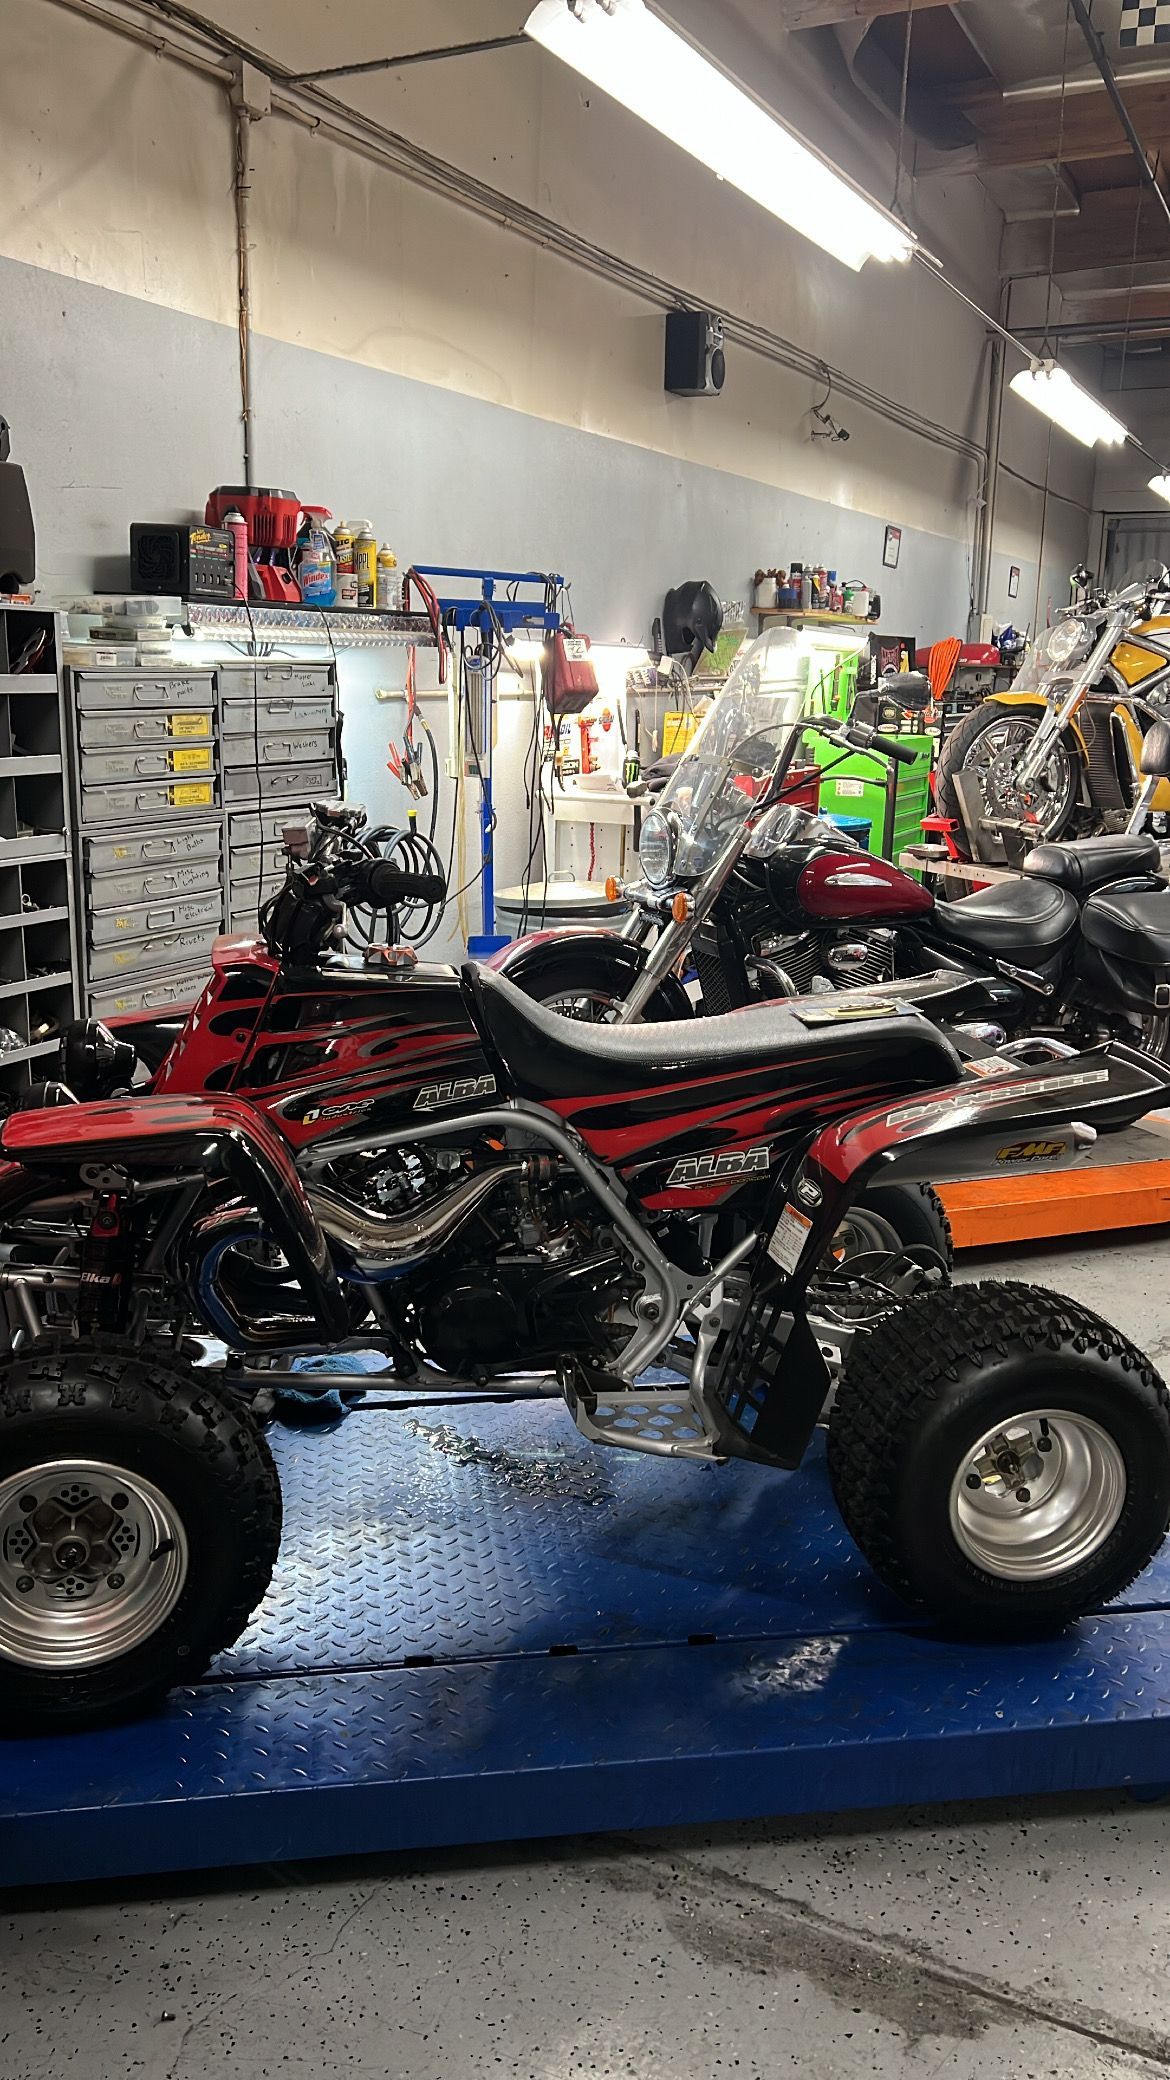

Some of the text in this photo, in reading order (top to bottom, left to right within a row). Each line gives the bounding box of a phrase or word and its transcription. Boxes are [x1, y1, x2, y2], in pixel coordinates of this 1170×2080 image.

[303, 571, 329, 587] Windex
[179, 934, 205, 947] Rivets
[413, 1074, 497, 1109] ALBA
[886, 1069, 1109, 1127] BANSHEE
[997, 1142, 1066, 1160] FMF
[666, 1147, 770, 1184] ALBA
[81, 1271, 111, 1284] Elka
